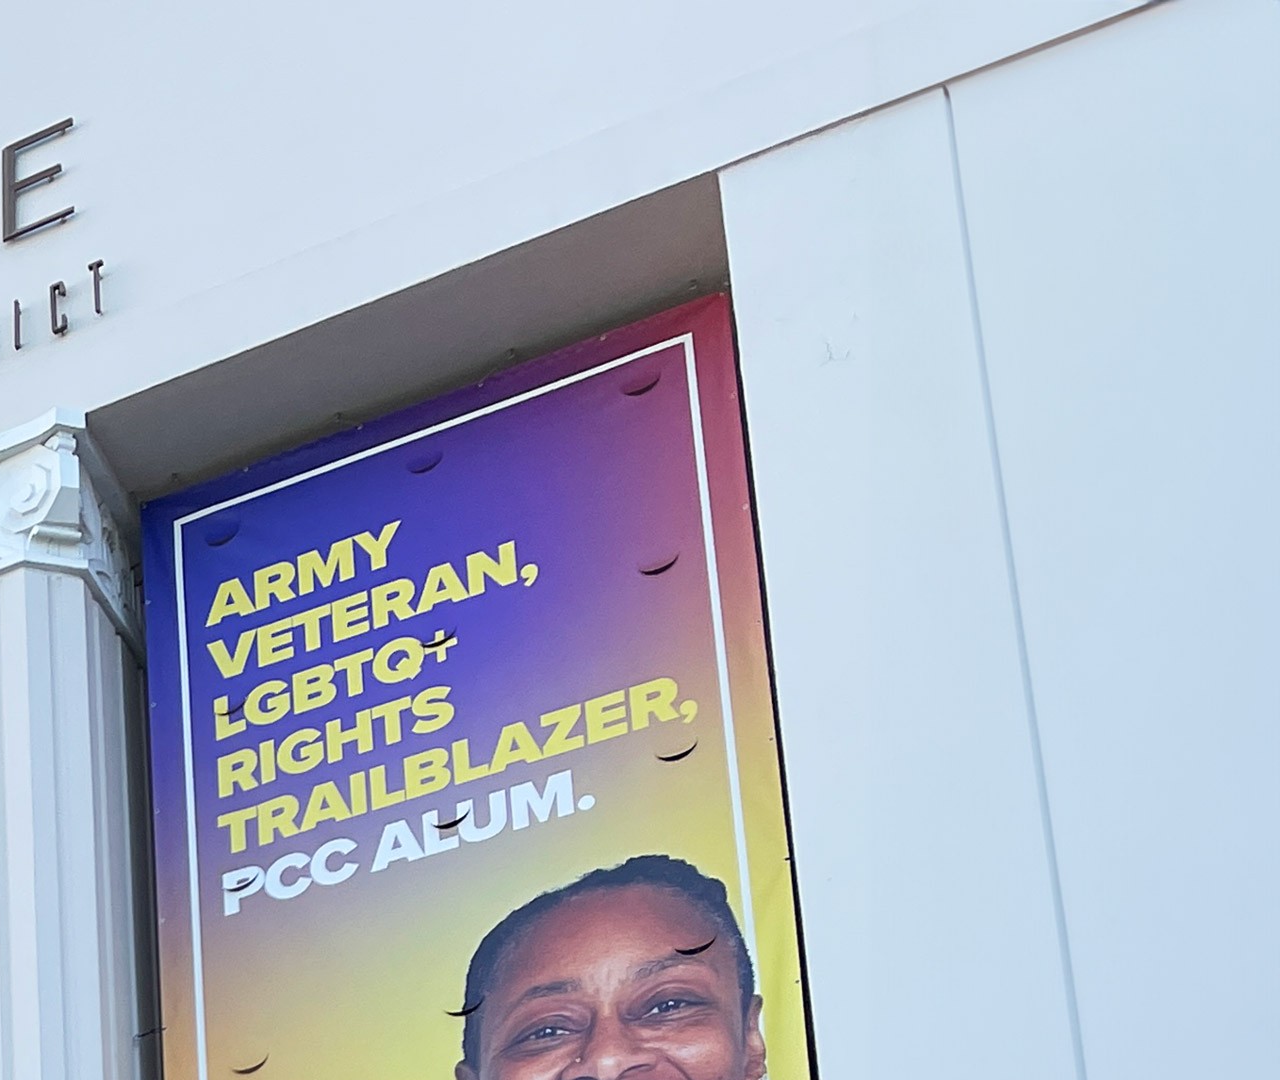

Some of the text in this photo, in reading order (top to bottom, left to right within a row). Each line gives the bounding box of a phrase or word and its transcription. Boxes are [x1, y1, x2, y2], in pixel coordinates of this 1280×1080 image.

[205, 520, 401, 628] ARMY
[206, 540, 538, 679] VETERAN,
[213, 629, 458, 741] LGBTQ+
[216, 686, 455, 798] RIGHTS
[216, 677, 698, 854] TRAILBLAZER,
[221, 769, 596, 917] PCC ALUM.
